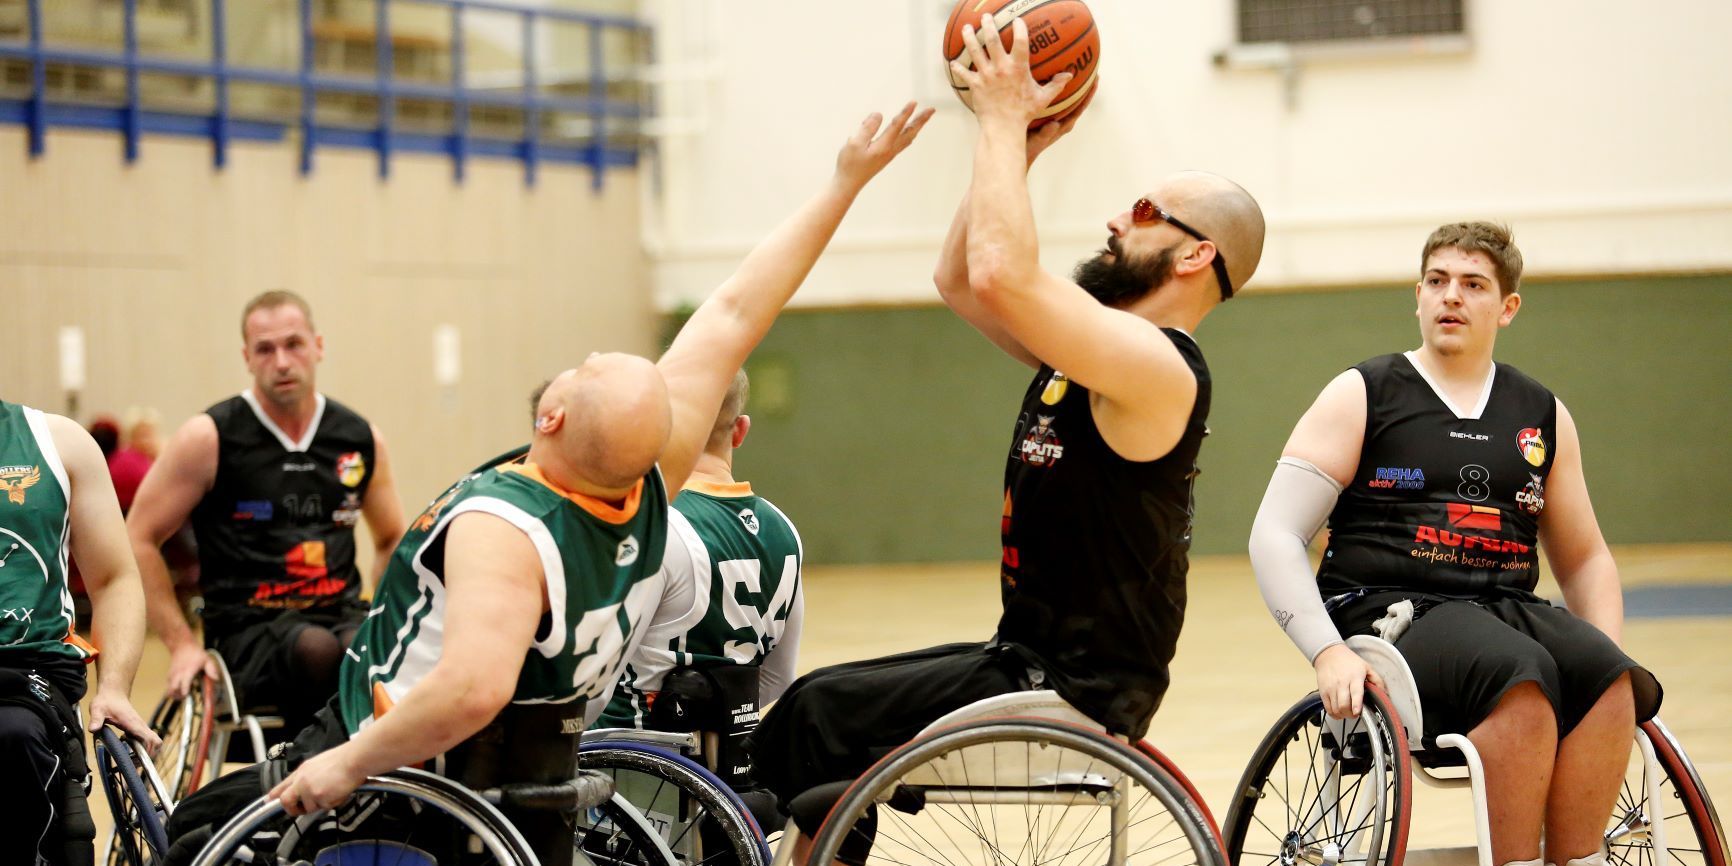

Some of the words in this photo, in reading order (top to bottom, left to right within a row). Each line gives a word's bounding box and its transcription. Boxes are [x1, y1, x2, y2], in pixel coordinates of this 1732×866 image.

[1449, 431, 1489, 441] BIEHLER
[0, 467, 32, 475] OLLERS
[1375, 467, 1425, 480] REHA
[1368, 479, 1396, 489] aktiv
[1395, 480, 1425, 490] 2000
[1457, 464, 1490, 502] 8
[1411, 546, 1458, 563] einfach
[1461, 552, 1498, 569] besser
[718, 554, 798, 665] 54
